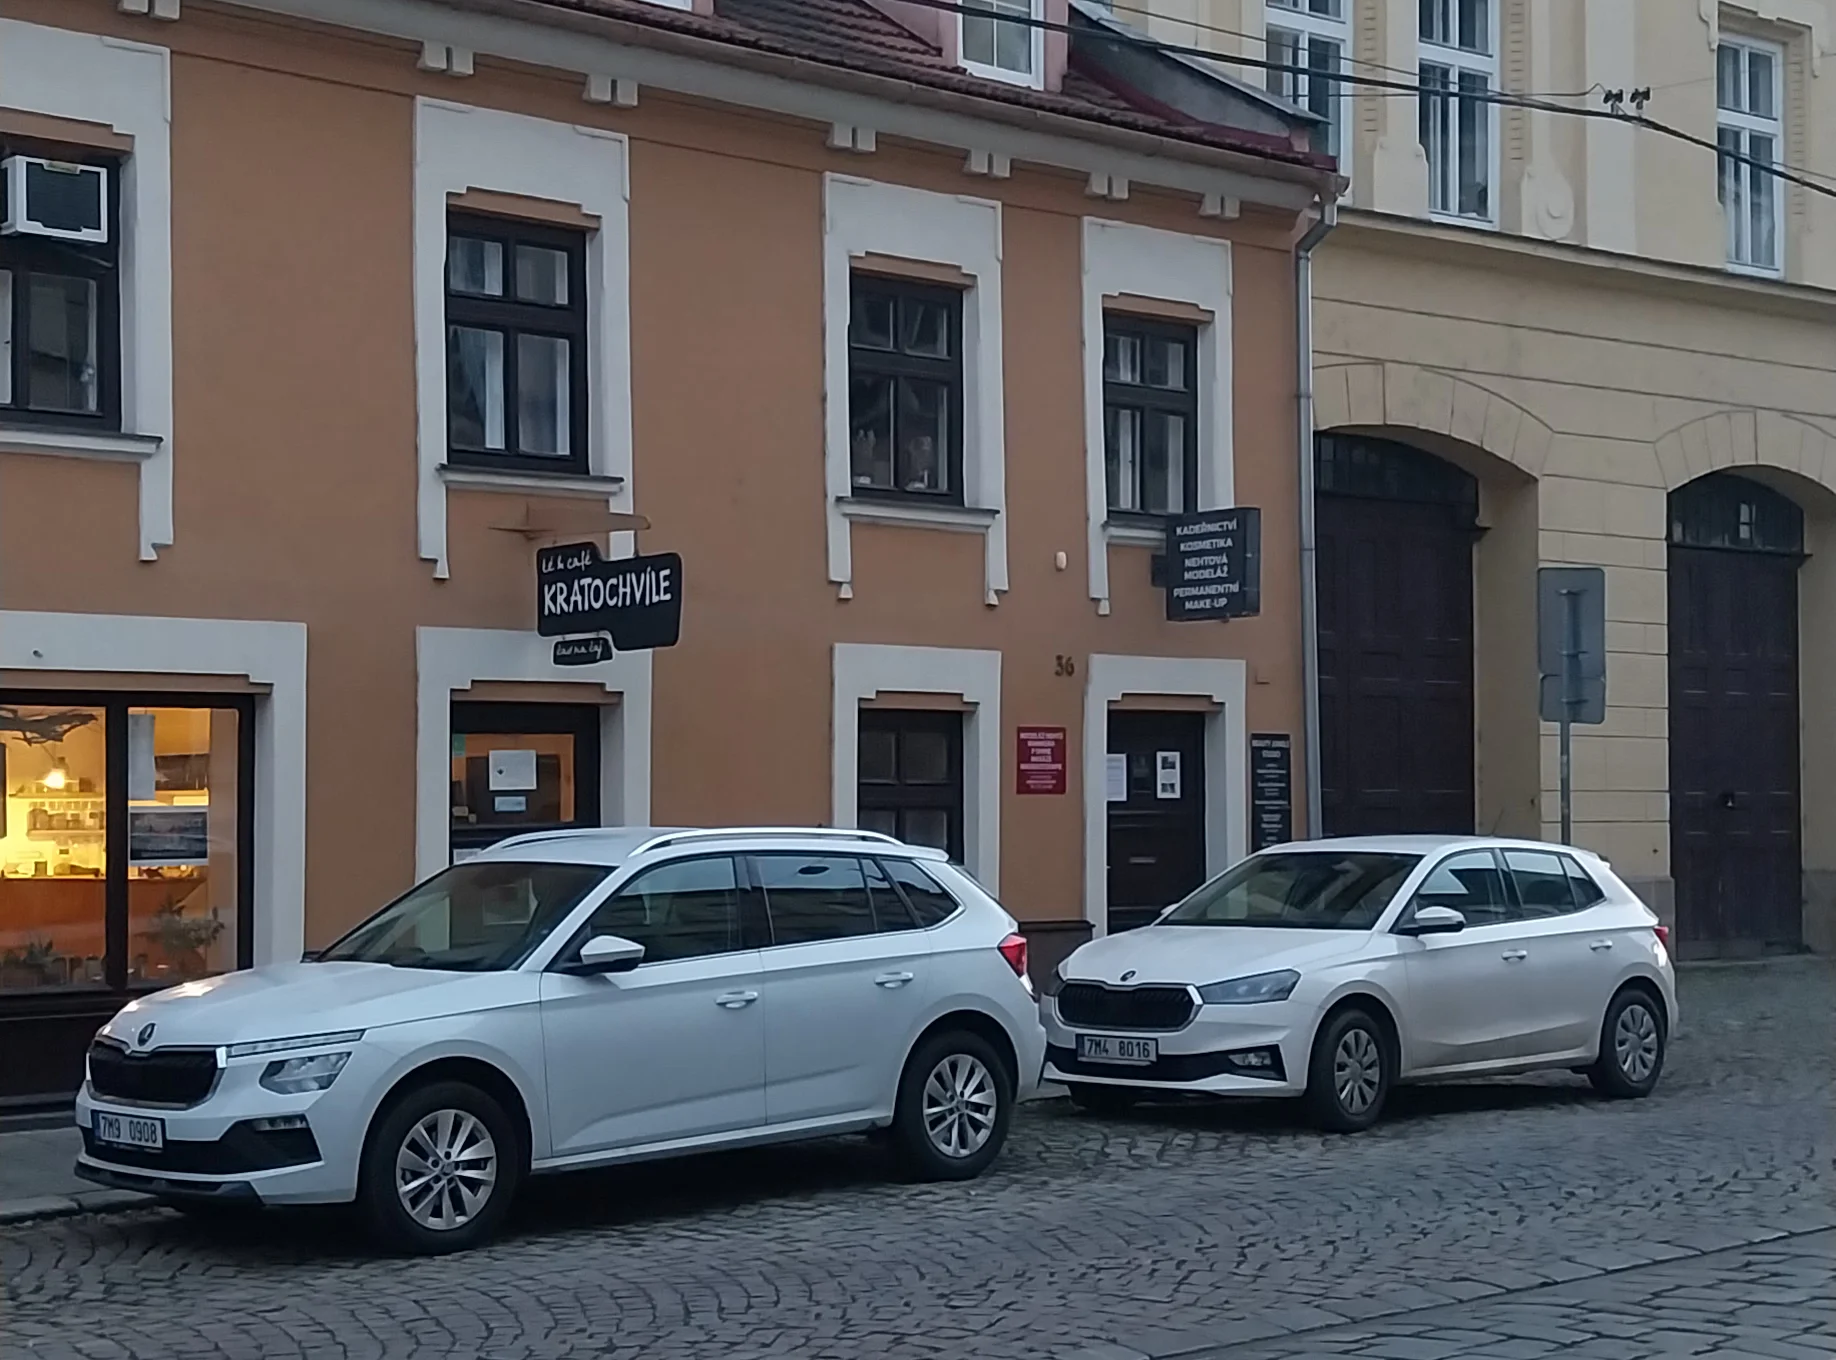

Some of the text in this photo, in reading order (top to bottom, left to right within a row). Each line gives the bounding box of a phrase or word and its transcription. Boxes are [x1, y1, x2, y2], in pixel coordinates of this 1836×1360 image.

[1176, 518, 1238, 537] KADEŘNICTVÍ
[1180, 537, 1233, 552] KOSMETIKA
[1184, 552, 1228, 568] NEHTOVÁ
[1184, 565, 1229, 580] MODELÁŽ
[544, 565, 672, 616] KRATOCHVÍLE
[1173, 581, 1240, 598] PERMANENTNÍ
[1185, 597, 1228, 610] MAKE-UP
[1054, 654, 1075, 677] 36
[1087, 1038, 1151, 1058] 7M4 8016
[101, 1116, 158, 1144] 7M9 0908
